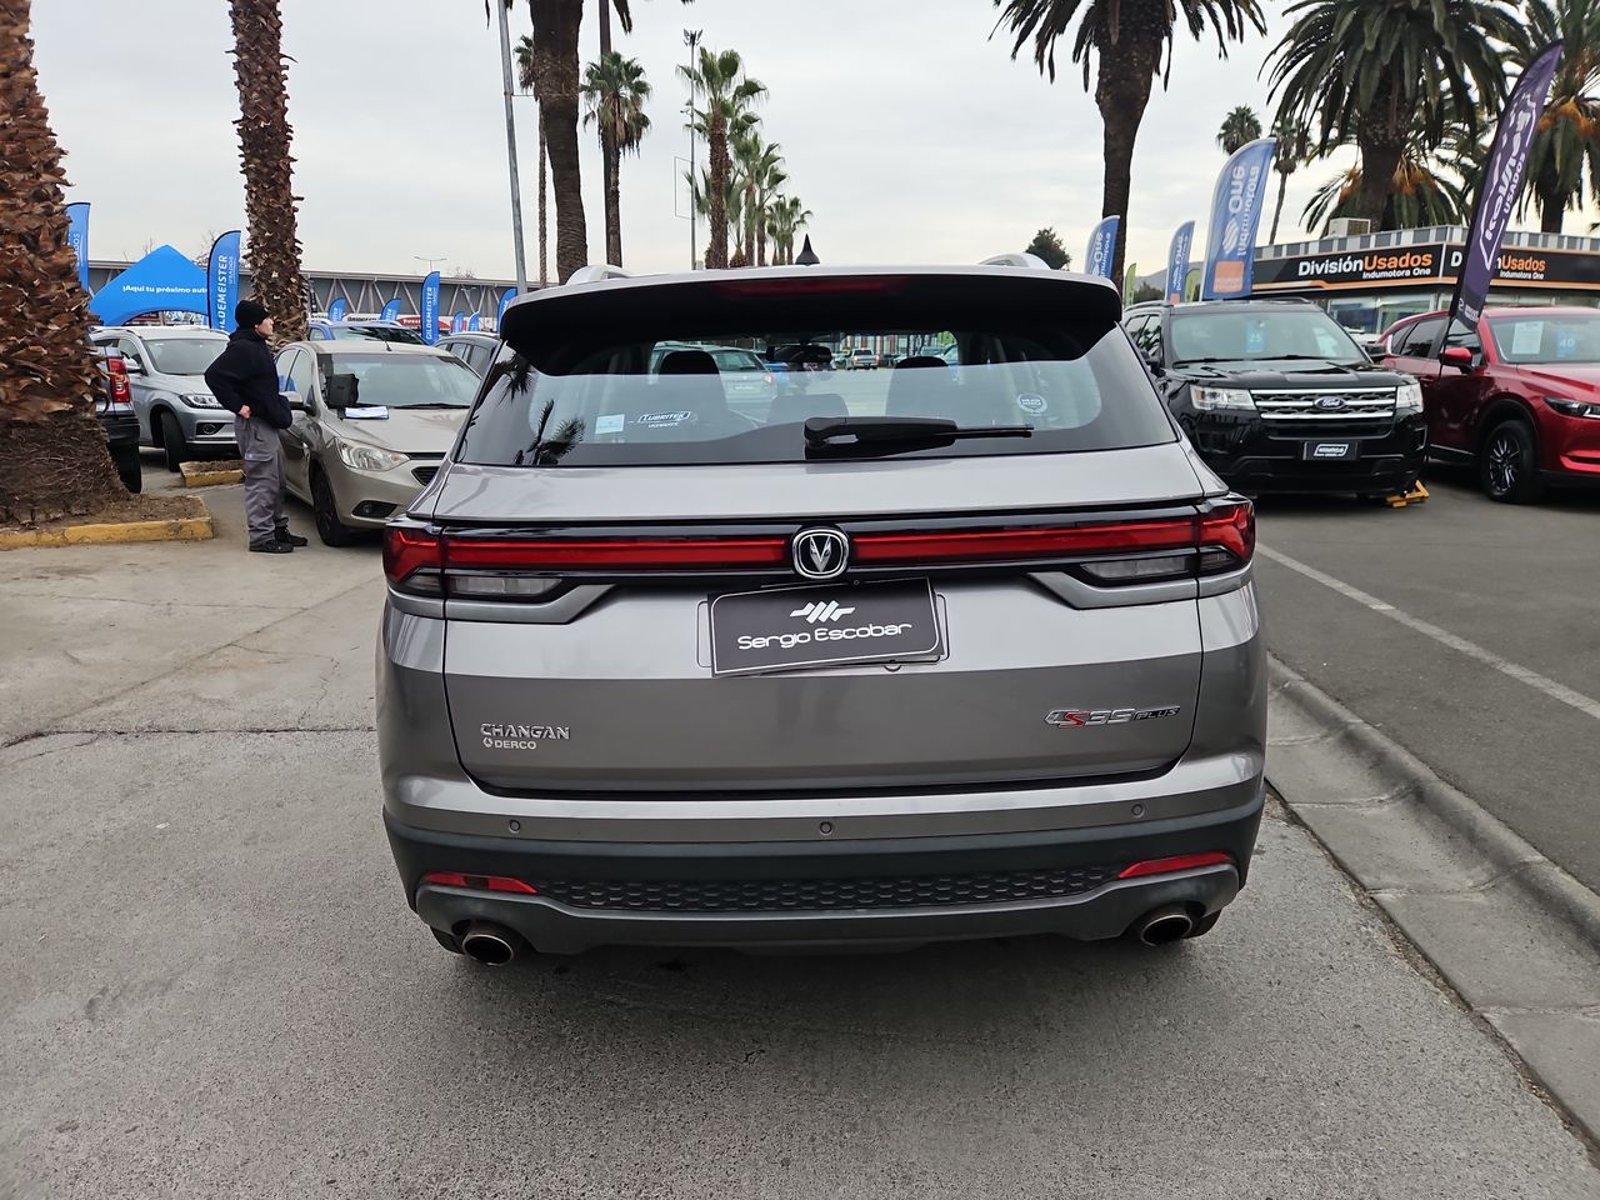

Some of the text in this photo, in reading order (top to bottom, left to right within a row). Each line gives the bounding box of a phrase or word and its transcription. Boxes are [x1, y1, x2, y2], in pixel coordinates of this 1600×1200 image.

[1228, 165, 1246, 213] One
[1503, 152, 1526, 214] USADOS
[1362, 267, 1431, 280] Indumotora One
[1532, 271, 1545, 280] One
[737, 623, 912, 650] Sergio Escobar
[1134, 705, 1181, 721] PLUS
[480, 723, 570, 740] CHANGAN
[494, 739, 537, 750] DERCO
